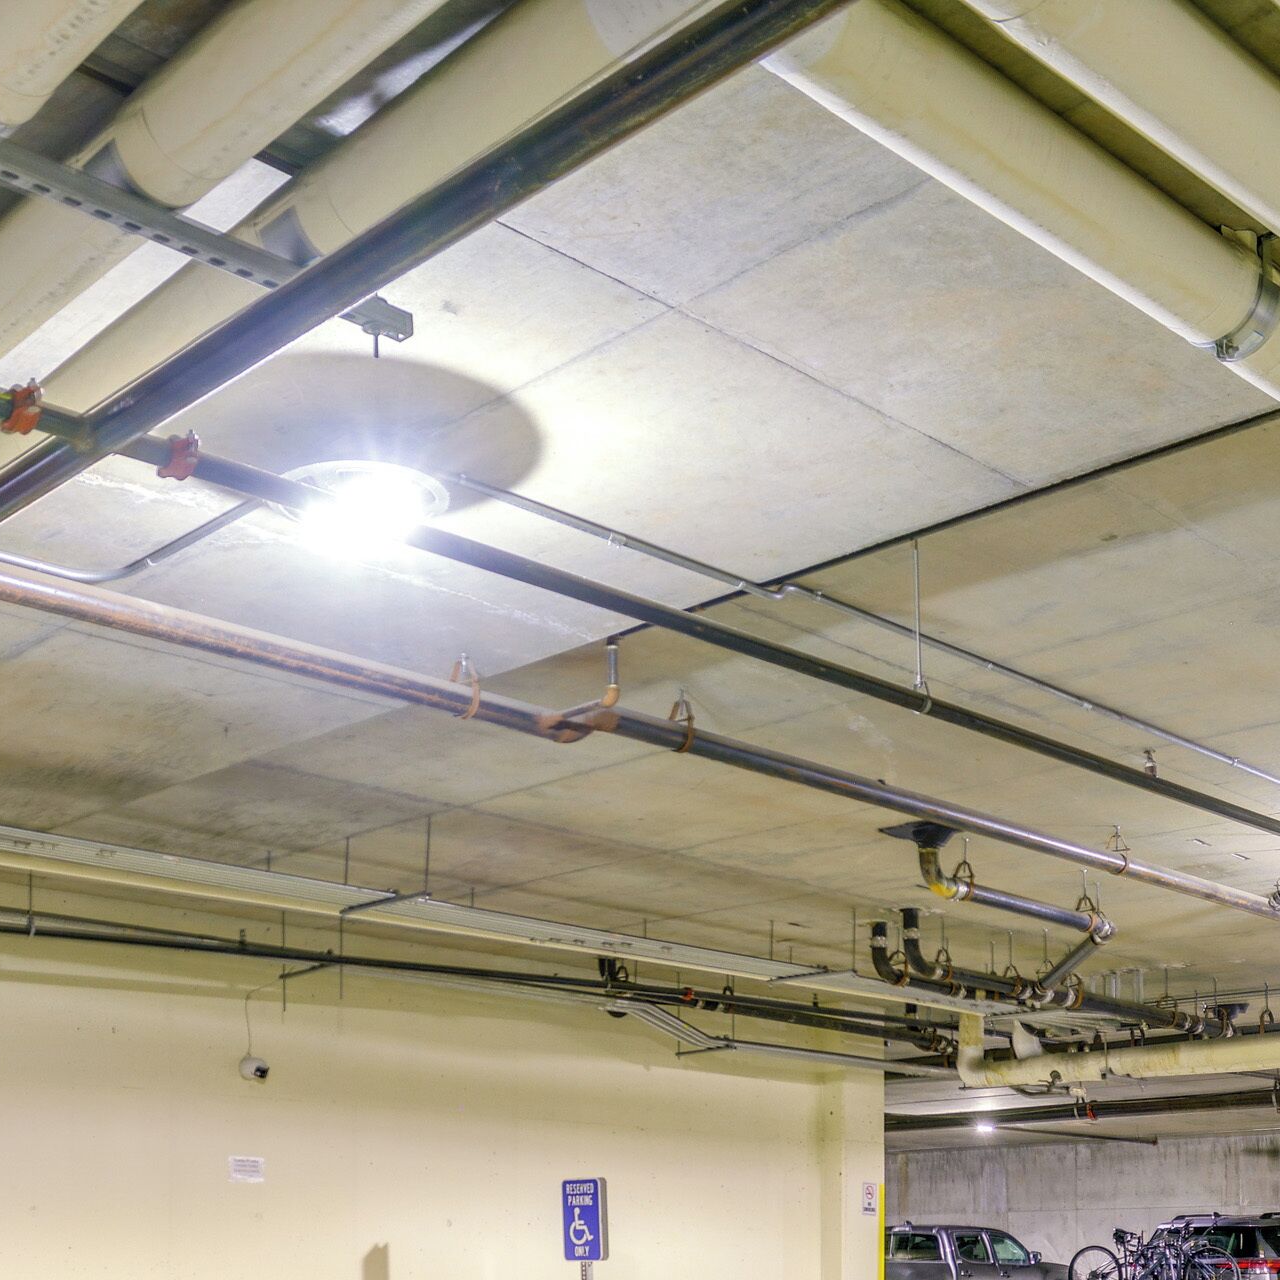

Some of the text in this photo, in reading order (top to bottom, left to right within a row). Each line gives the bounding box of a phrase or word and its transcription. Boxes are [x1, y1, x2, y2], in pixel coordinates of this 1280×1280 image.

[566, 1183, 594, 1194] RESERVED
[568, 1195, 593, 1206] PARKING
[574, 1246, 590, 1257] ONLY
